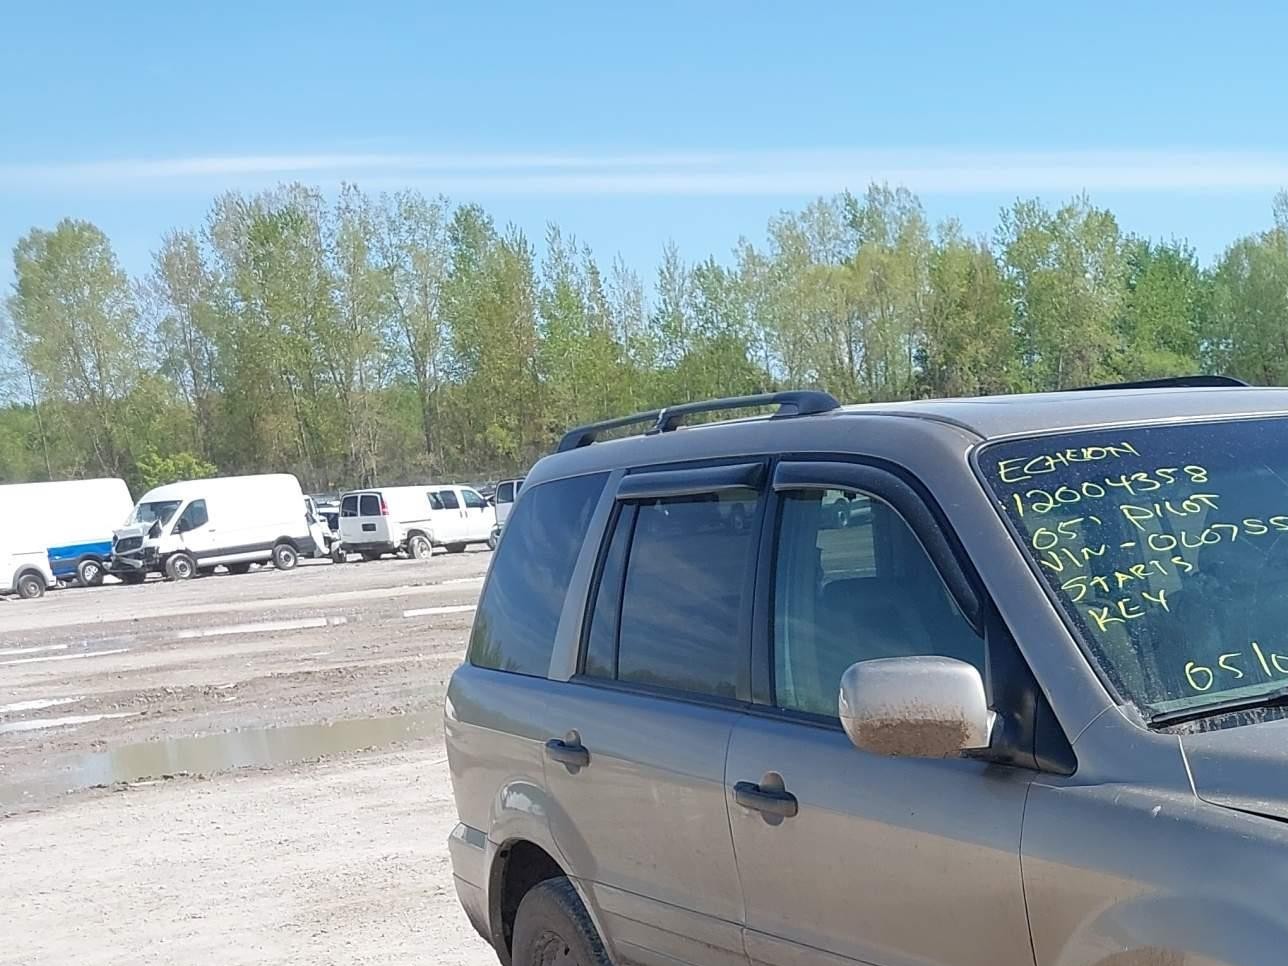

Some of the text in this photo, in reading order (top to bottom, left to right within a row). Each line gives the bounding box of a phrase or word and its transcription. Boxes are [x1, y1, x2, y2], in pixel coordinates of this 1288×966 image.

[999, 442, 1141, 483] ECHELON
[1013, 465, 1209, 517] 12004358
[1120, 494, 1220, 531] PILOT
[1041, 544, 1106, 572] VIN
[1061, 556, 1193, 602] STARTS
[1088, 590, 1170, 632] KEY
